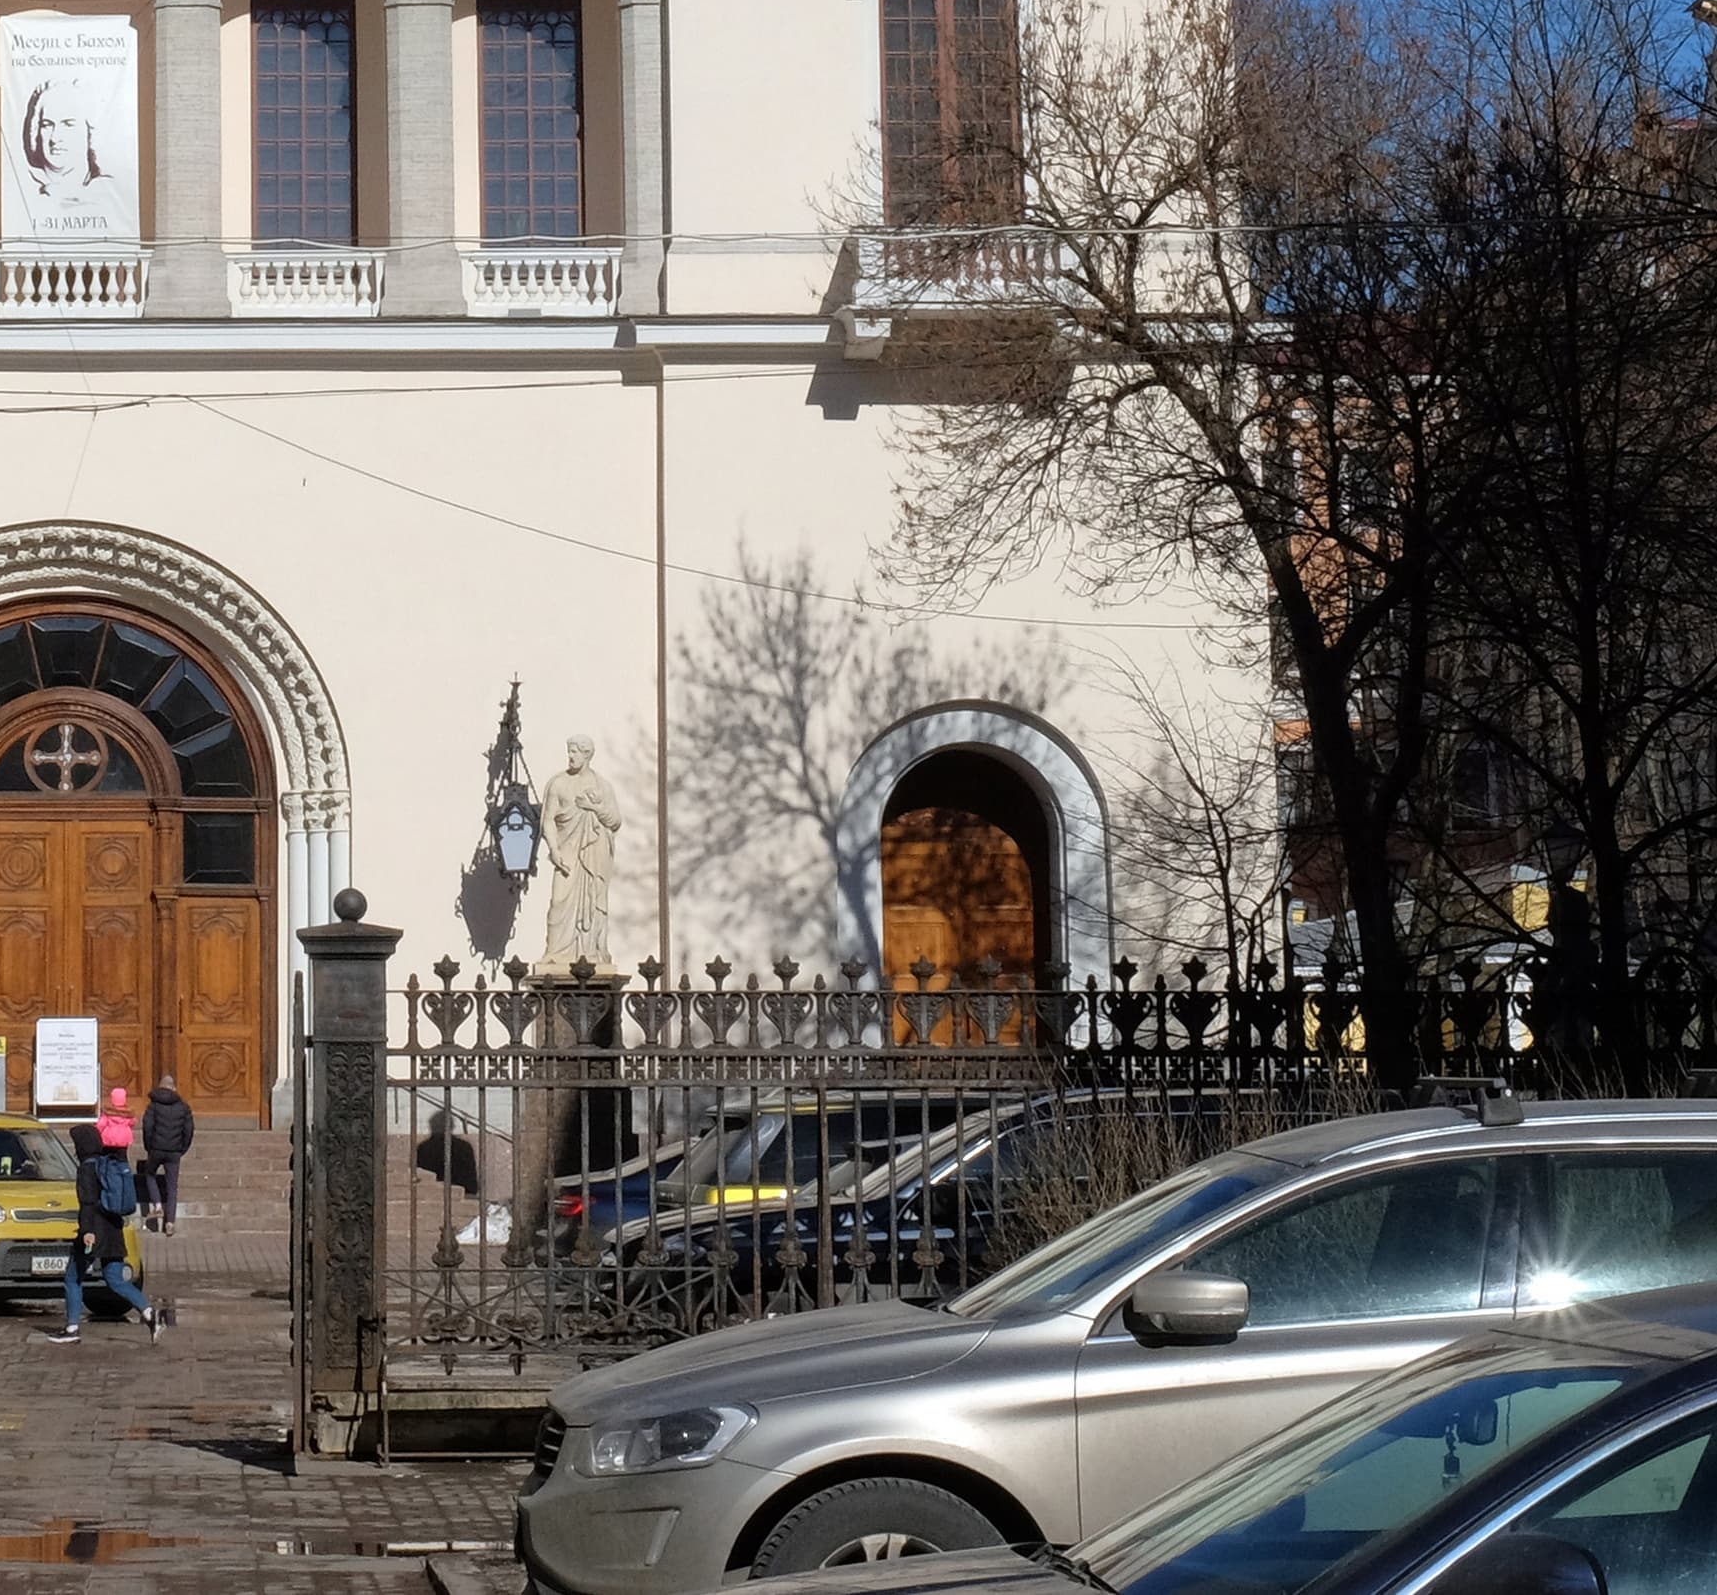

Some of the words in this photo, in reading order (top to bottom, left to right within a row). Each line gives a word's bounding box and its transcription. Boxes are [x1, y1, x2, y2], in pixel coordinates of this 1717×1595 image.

[12, 34, 60, 51] Месяц
[64, 37, 72, 48] с
[77, 33, 125, 48] Бахом
[11, 58, 26, 67] на
[28, 54, 85, 67] большом
[87, 56, 127, 68] органе
[61, 216, 108, 230] МАРТА
